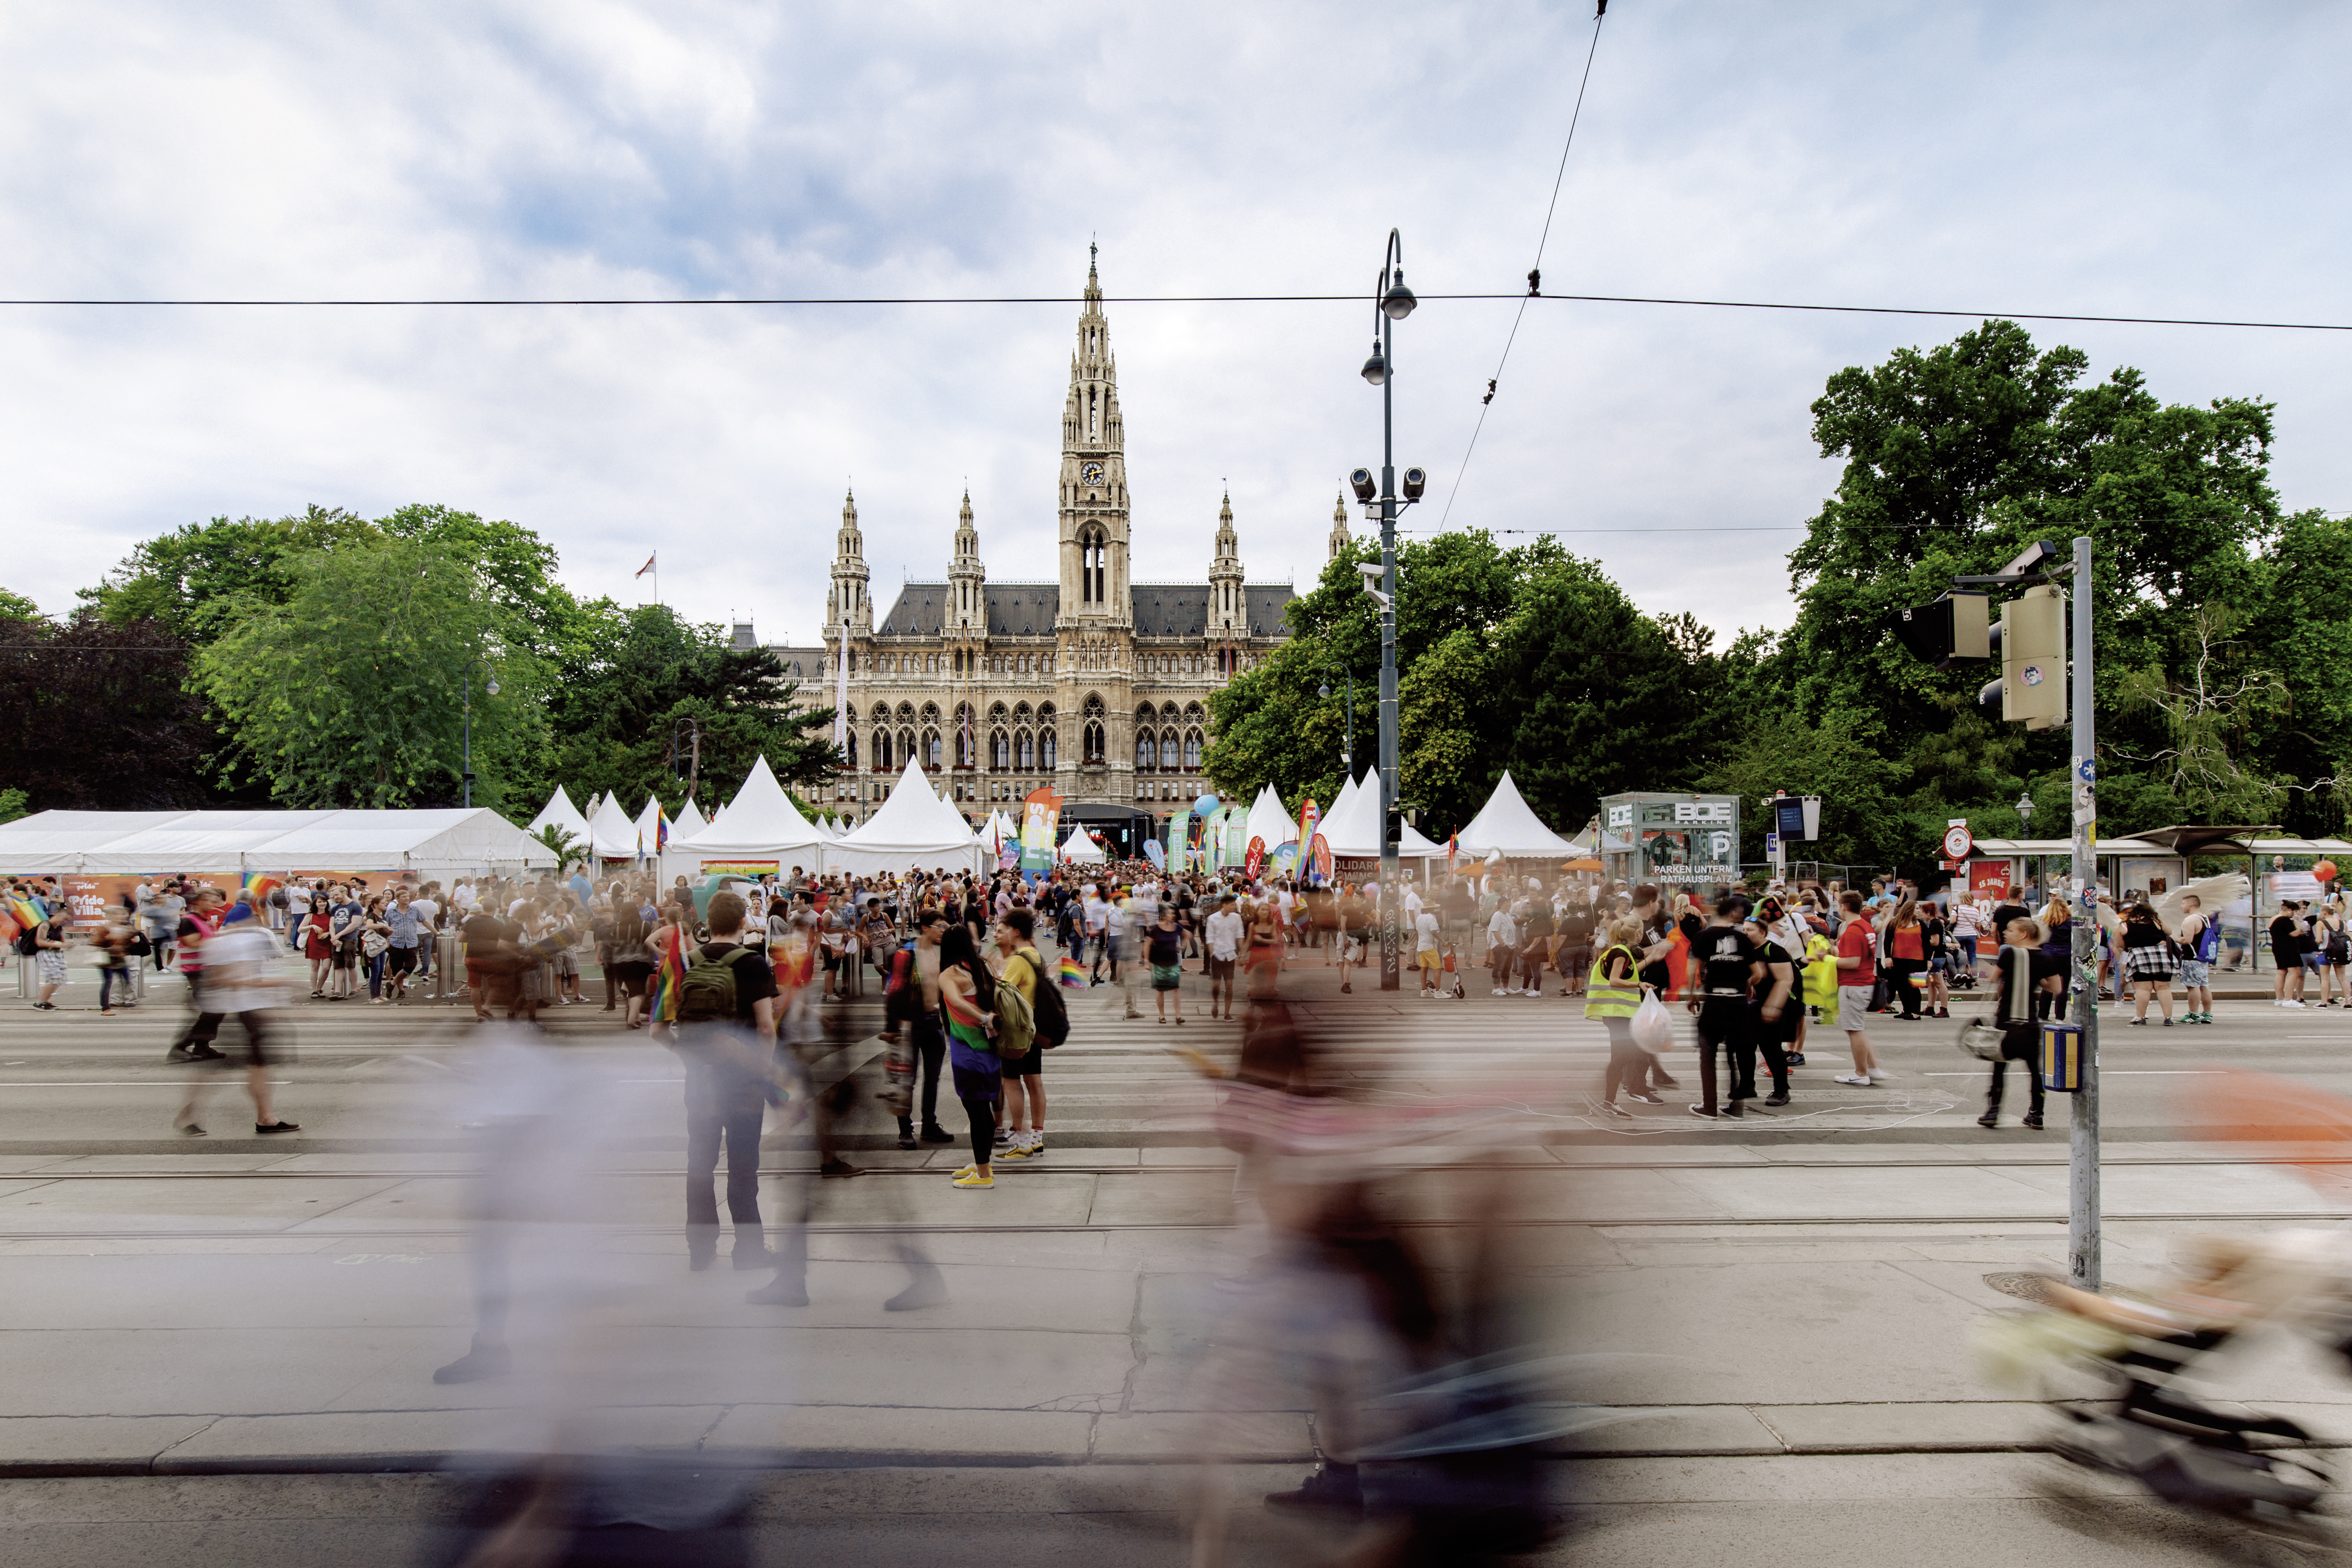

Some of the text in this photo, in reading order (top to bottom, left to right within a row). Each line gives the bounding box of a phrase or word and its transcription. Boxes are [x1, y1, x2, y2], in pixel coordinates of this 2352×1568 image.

[1903, 610, 1910, 620] 5
[1980, 694, 1985, 703] 3
[1609, 804, 1632, 826] BOE
[1675, 803, 1731, 820] BOE
[1026, 803, 1044, 859] neos
[1947, 829, 1968, 841] STRASSENBAHN
[1713, 838, 1730, 860] P
[1948, 845, 1968, 855] HALTESTELLE
[1979, 878, 2005, 888] 15 JAHRE
[68, 894, 105, 905] Pride
[73, 905, 106, 917] Villa
